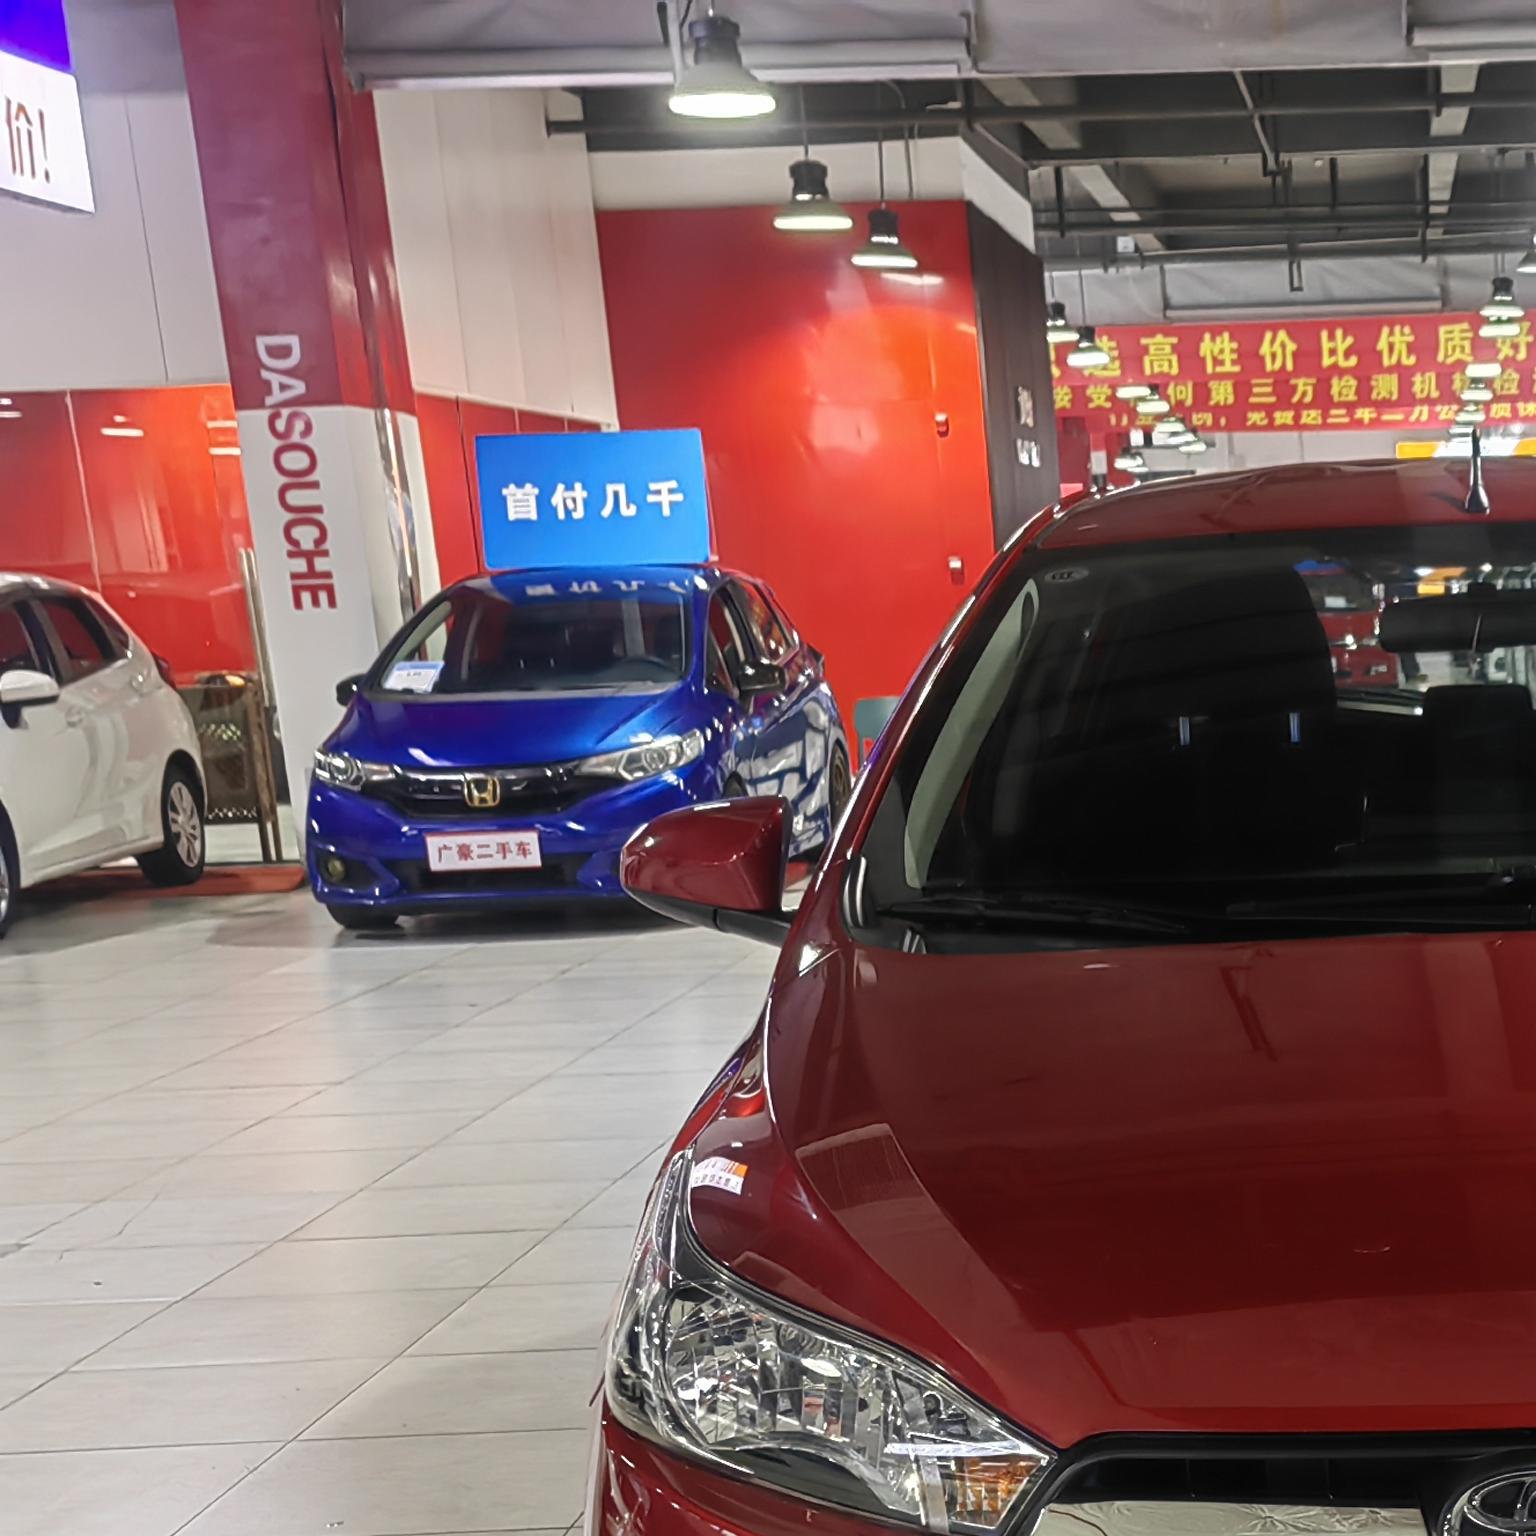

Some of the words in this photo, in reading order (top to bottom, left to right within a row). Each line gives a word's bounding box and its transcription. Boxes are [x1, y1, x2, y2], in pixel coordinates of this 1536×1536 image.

[255, 333, 338, 612] DASOUCHE
[502, 479, 685, 521] 首付几千
[436, 839, 533, 863] 广豪二手车
